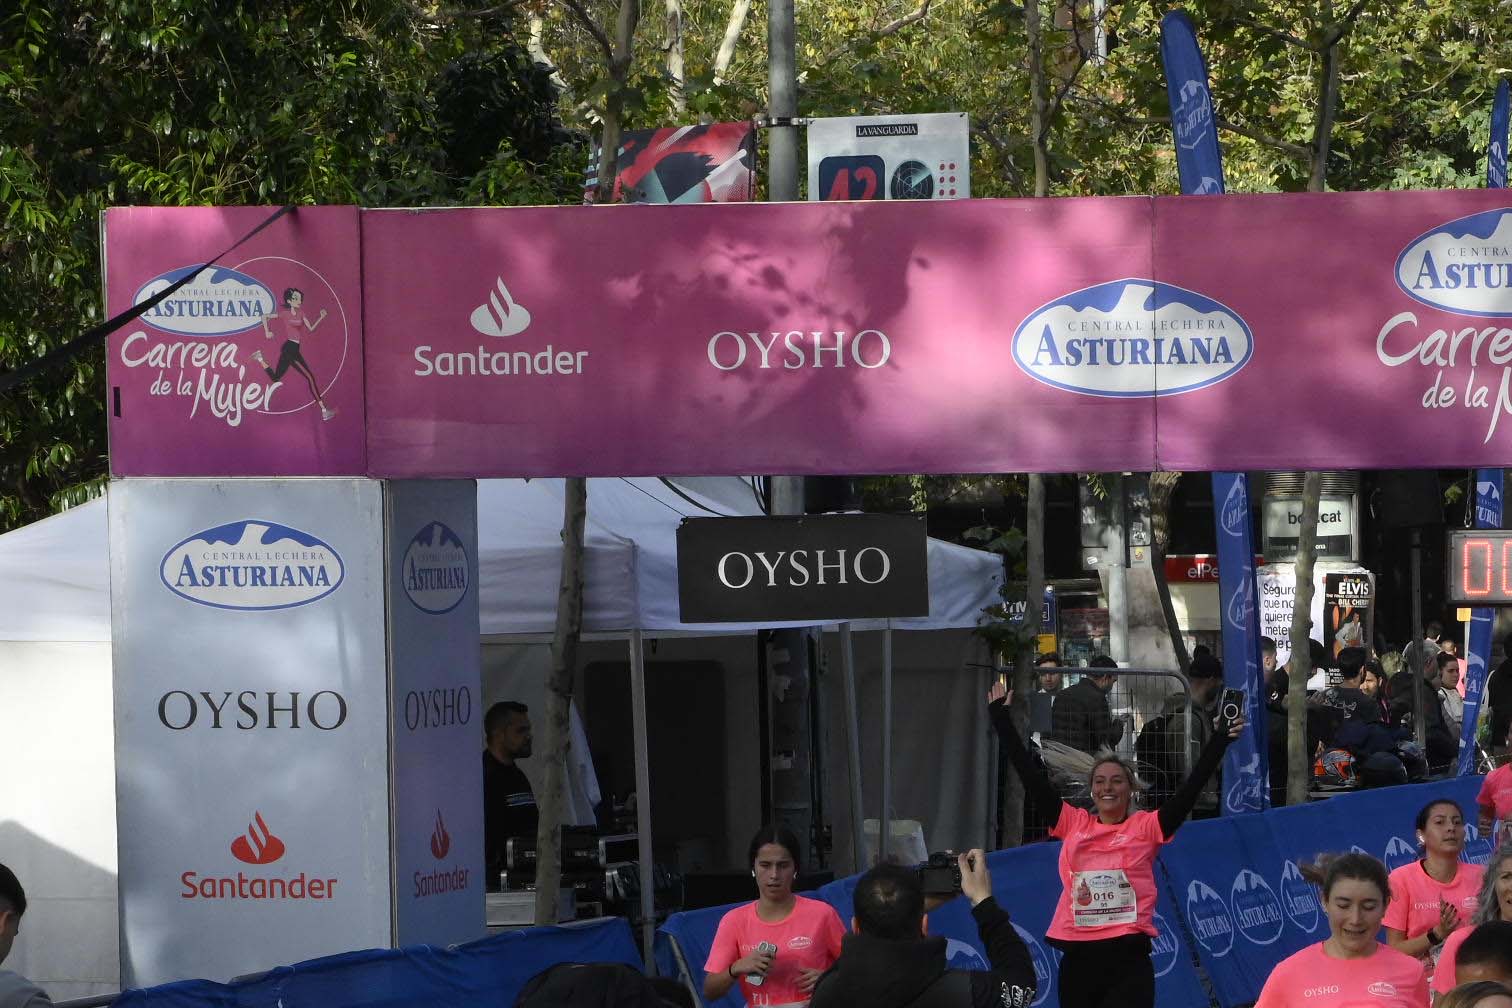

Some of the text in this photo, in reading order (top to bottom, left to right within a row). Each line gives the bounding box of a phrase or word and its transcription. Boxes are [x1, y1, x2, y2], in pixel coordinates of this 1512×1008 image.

[144, 291, 264, 317] ASTURIANA
[1067, 318, 1226, 332] CENTRAL LECHERA
[121, 331, 239, 368] Carrera
[414, 345, 589, 376] Santander
[707, 329, 891, 371] OYSHO
[1030, 323, 1235, 367] ASTURIANA
[150, 366, 283, 427] de la Mujer
[1422, 370, 1456, 408] de
[1464, 369, 1489, 408] la
[175, 554, 332, 588] ASTURIANA
[202, 551, 325, 561] CENTRAL LECHERA
[717, 547, 891, 589] OYSHO
[407, 555, 465, 592] ASTURIANA
[1338, 582, 1369, 595] ELVIS
[1264, 600, 1281, 612] que
[158, 690, 347, 731] OYSHO
[405, 686, 470, 731] OYSHO
[181, 871, 338, 900] Santander
[413, 865, 470, 898] Santander
[1093, 891, 1115, 901] 016
[1304, 985, 1339, 998] OYSHO
